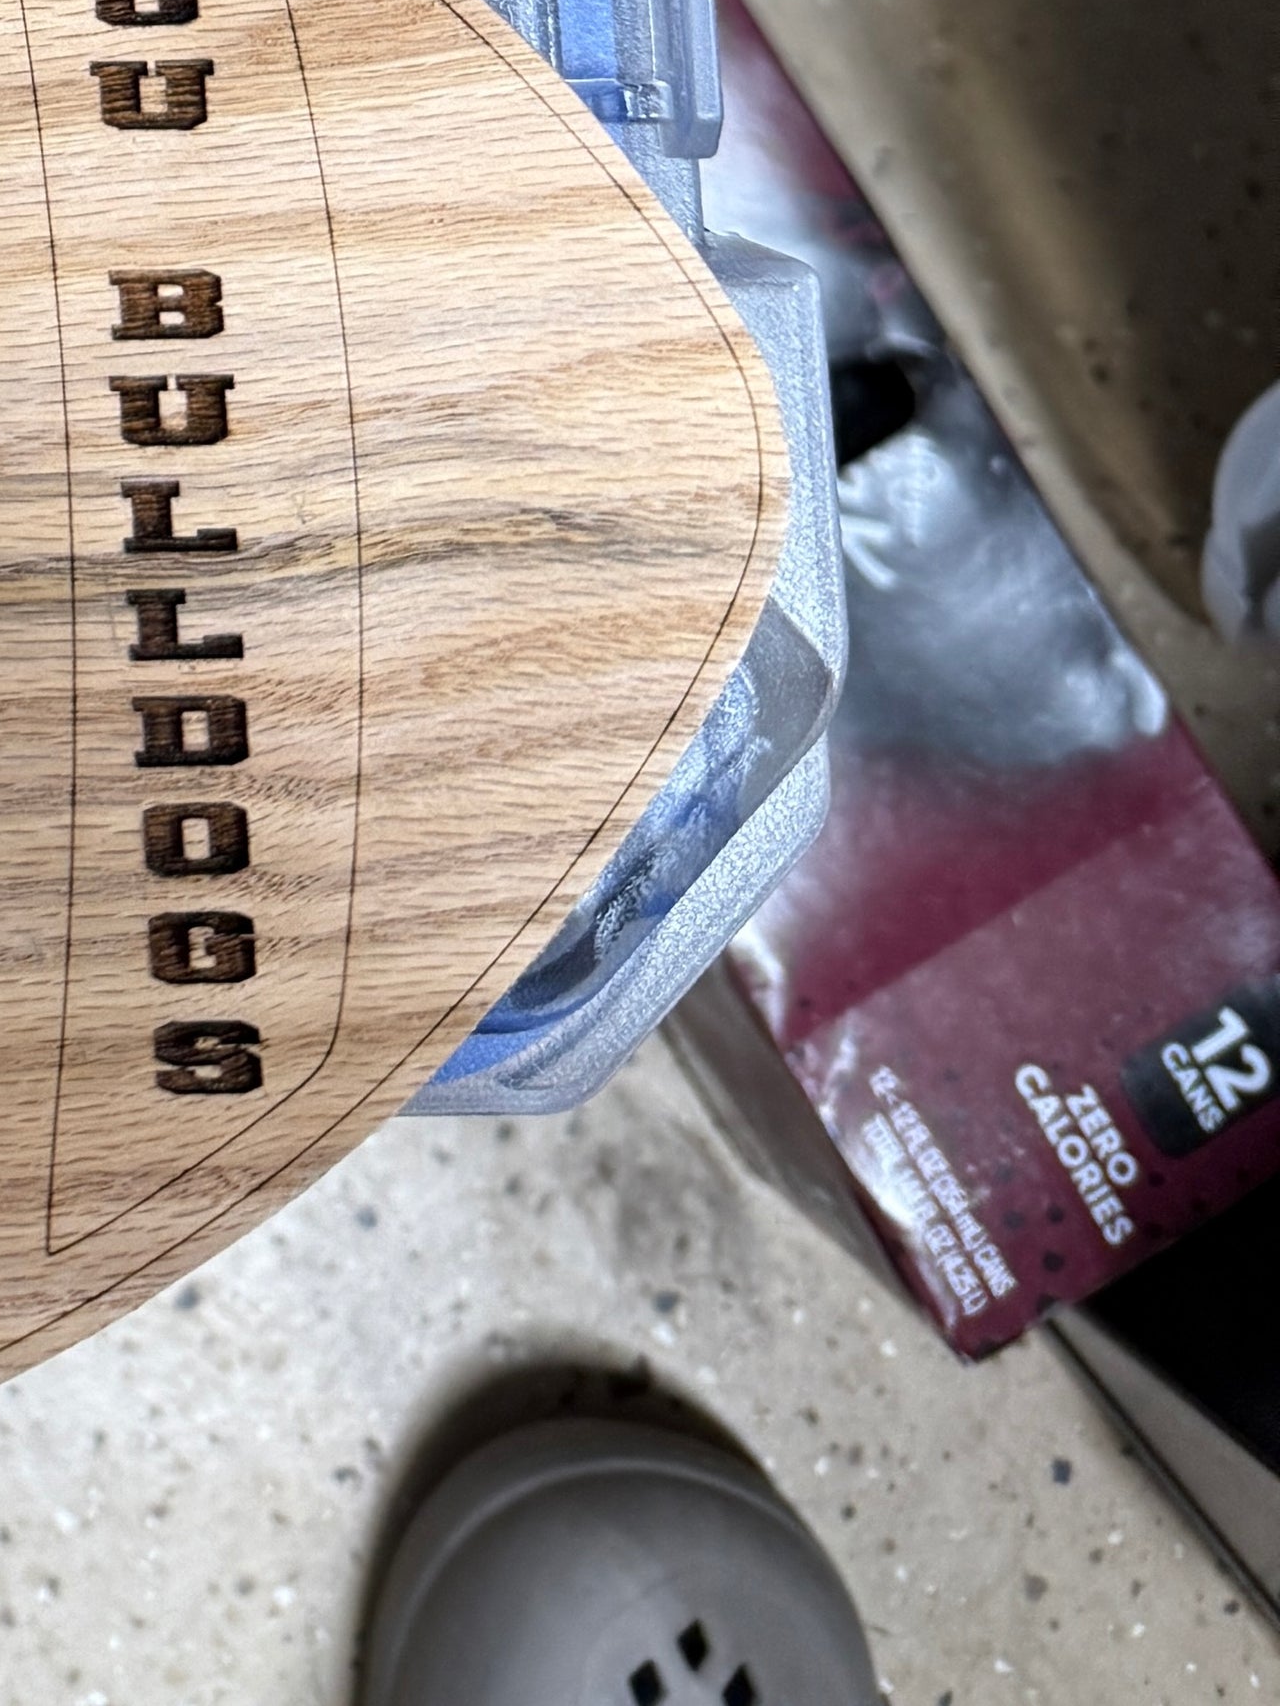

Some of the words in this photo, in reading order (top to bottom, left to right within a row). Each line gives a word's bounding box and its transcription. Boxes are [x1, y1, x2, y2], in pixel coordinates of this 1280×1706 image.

[107, 269, 263, 1097] BULLDOGS
[1162, 1042, 1226, 1133] CANS
[1191, 1006, 1272, 1111] 12
[1015, 1063, 1135, 1246] CALORIES
[1064, 1082, 1138, 1186] ZERO
